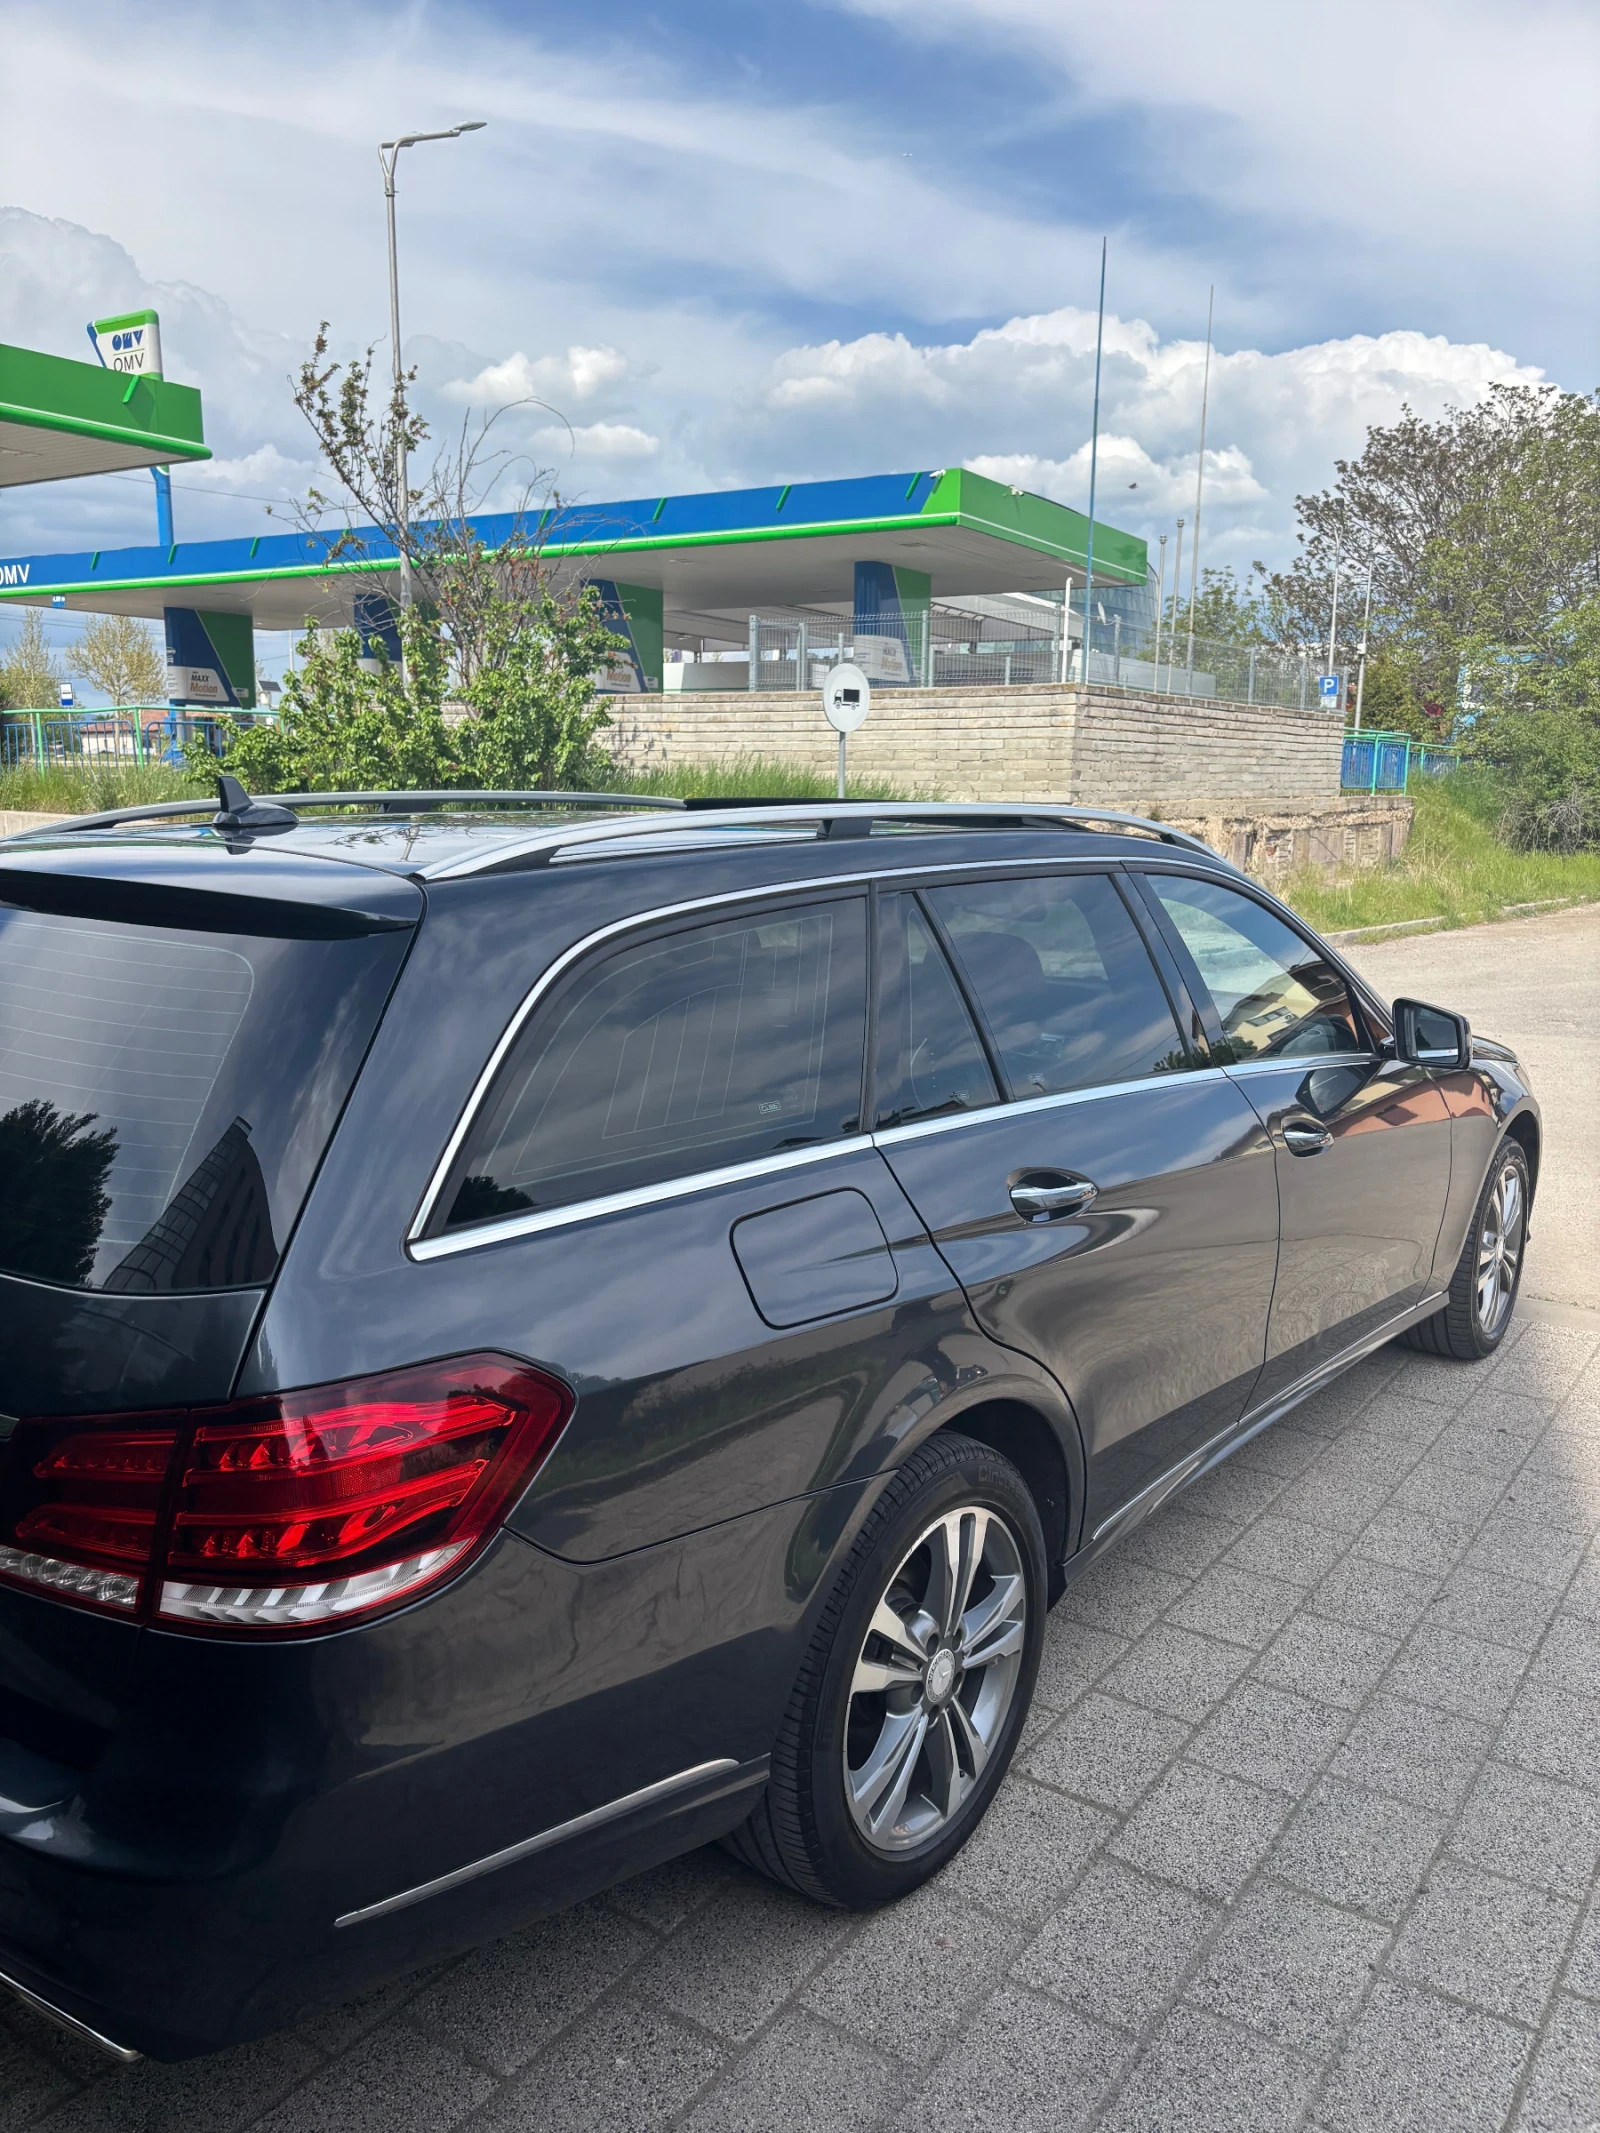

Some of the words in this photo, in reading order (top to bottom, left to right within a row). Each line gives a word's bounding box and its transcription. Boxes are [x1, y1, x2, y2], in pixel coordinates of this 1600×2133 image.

[112, 329, 143, 351] OMV
[113, 352, 144, 372] OMV
[190, 682, 218, 694] Motion
[1323, 678, 1335, 694] P
